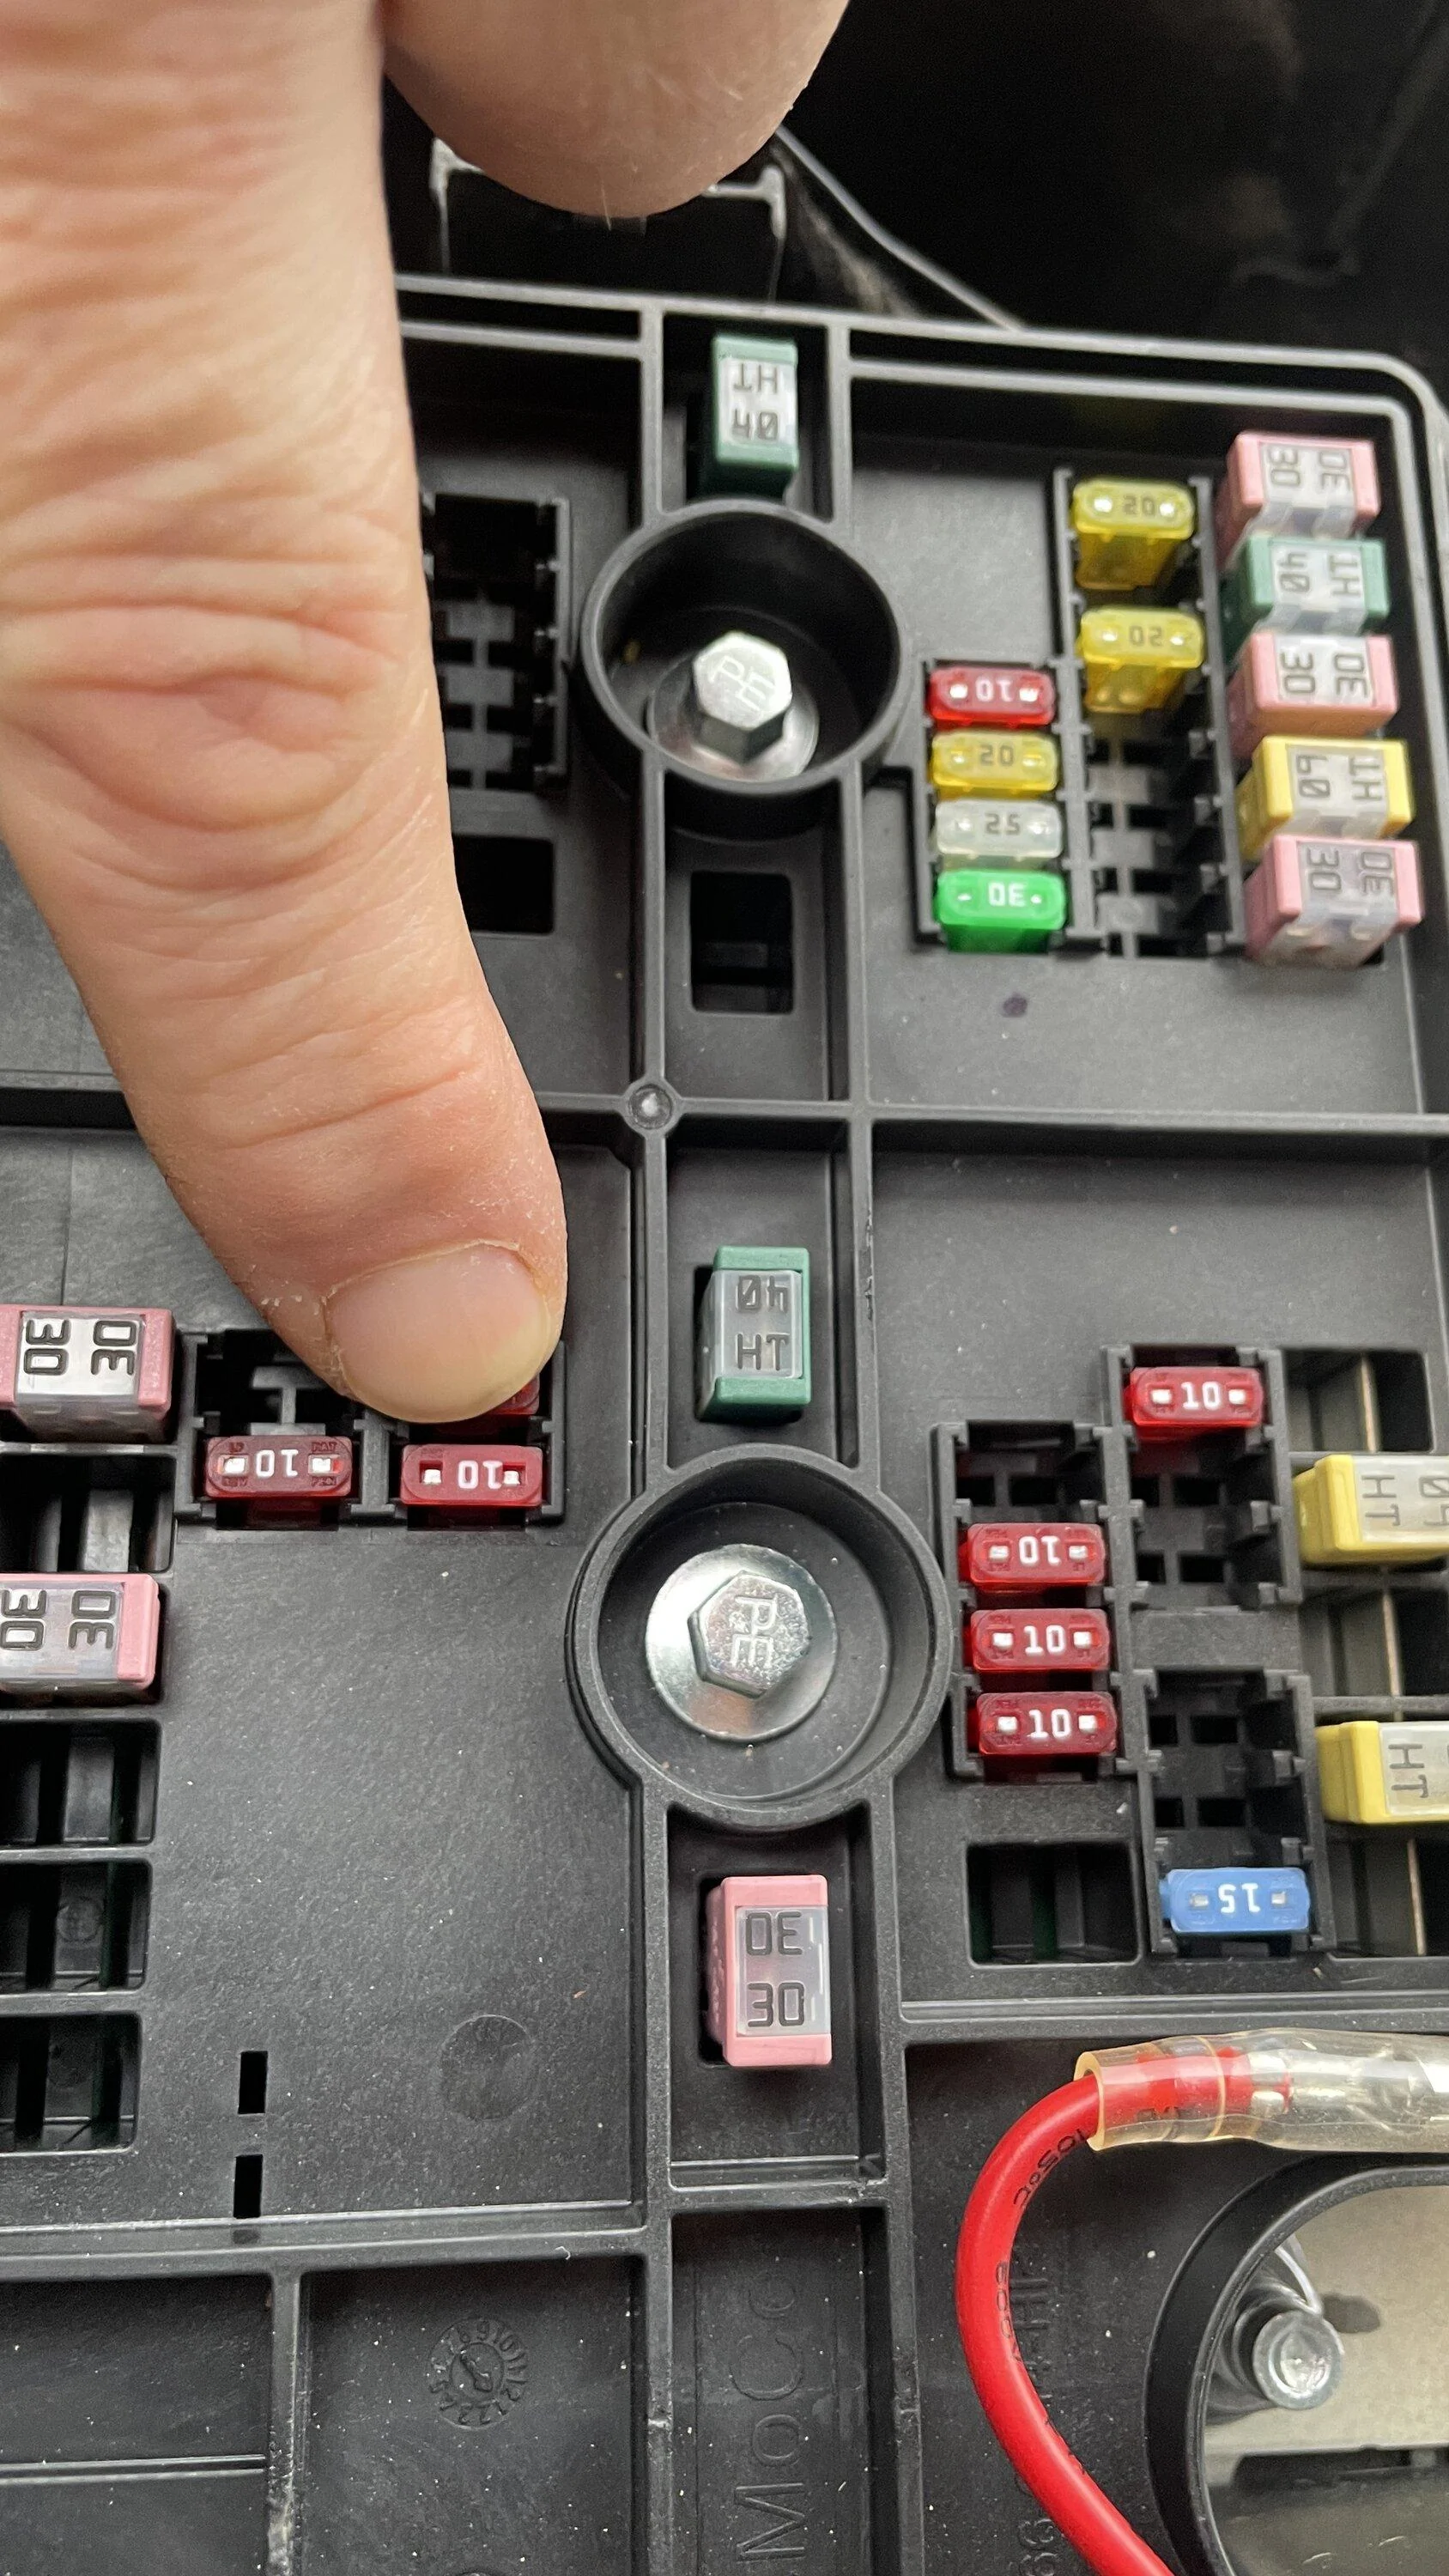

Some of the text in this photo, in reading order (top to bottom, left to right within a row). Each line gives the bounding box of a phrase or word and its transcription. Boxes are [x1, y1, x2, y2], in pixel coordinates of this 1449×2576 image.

[731, 408, 779, 440] 40
[975, 676, 1014, 703] 10
[979, 744, 1015, 767] 20
[985, 812, 1021, 835] 25
[737, 1274, 790, 1314] 40
[736, 1333, 791, 1371] HT
[1181, 1381, 1222, 1411] 10
[255, 1449, 299, 1479] 10
[457, 1459, 504, 1490] 10
[1361, 1474, 1402, 1527] HT
[1018, 1535, 1062, 1567] 10
[1023, 1625, 1067, 1656] 10
[1028, 1708, 1073, 1740] 10
[1388, 1744, 1429, 1799] HT
[1217, 1882, 1261, 1914] 15
[748, 1982, 805, 2028] 30
